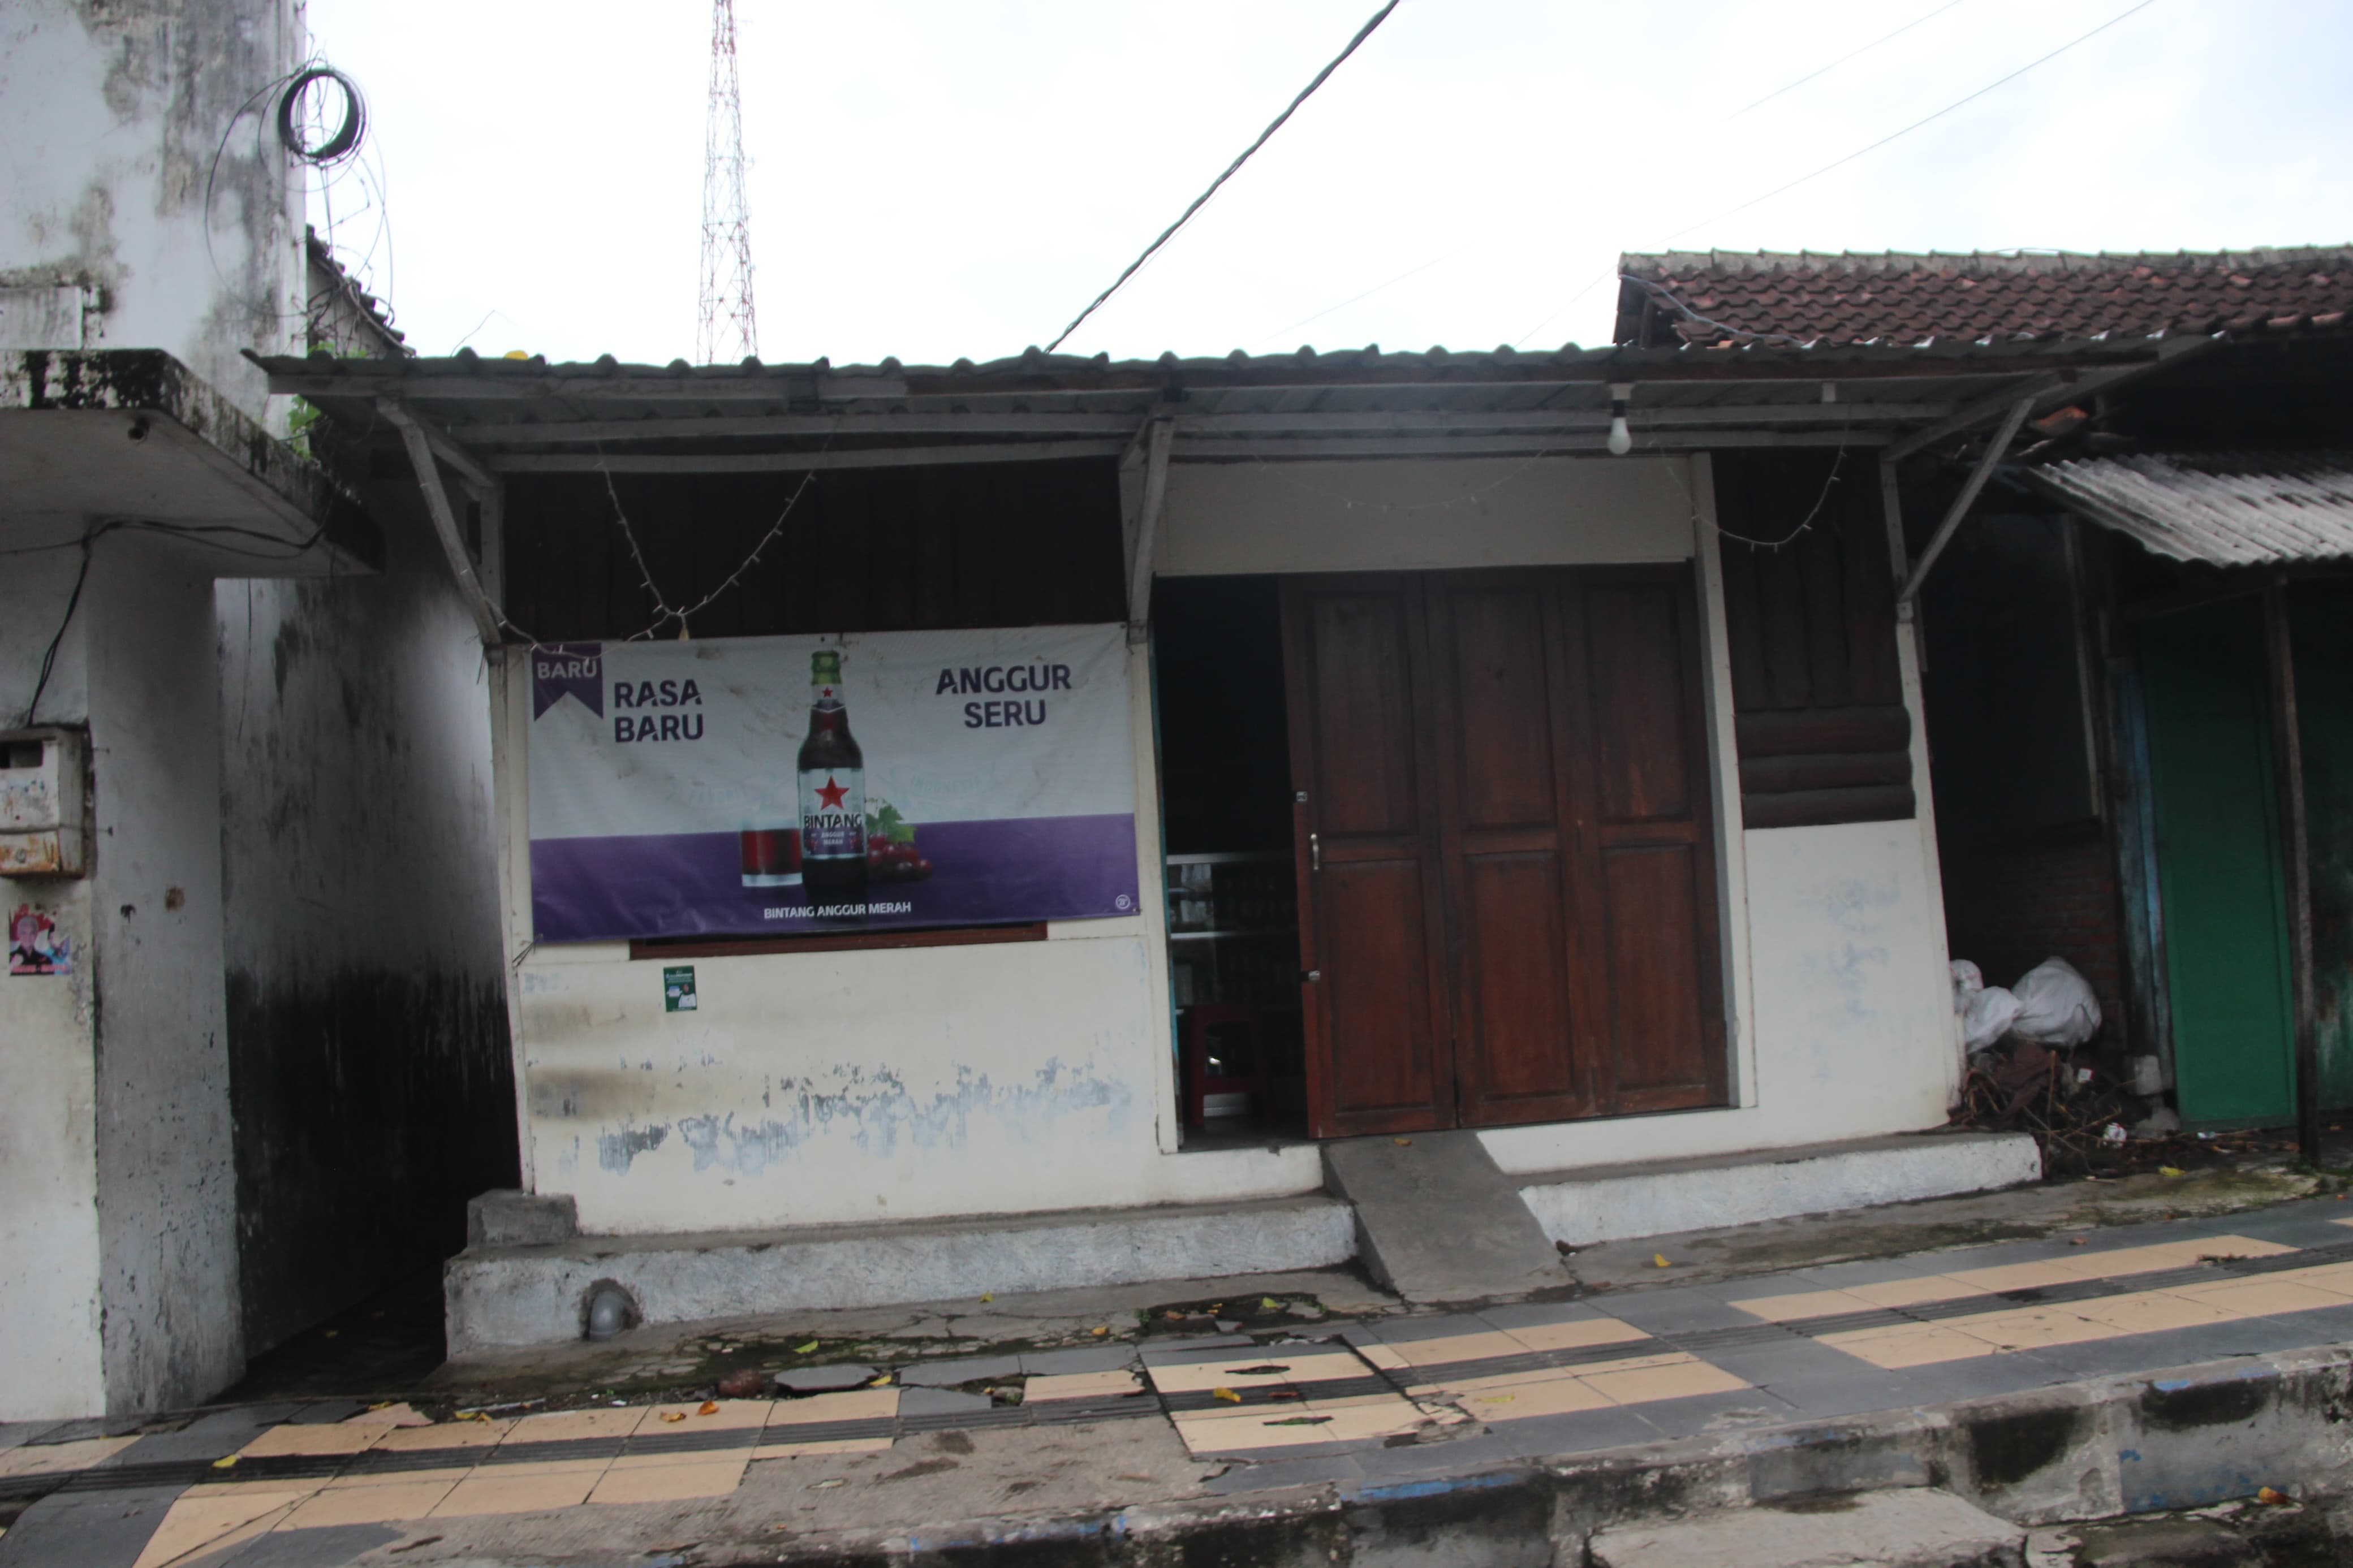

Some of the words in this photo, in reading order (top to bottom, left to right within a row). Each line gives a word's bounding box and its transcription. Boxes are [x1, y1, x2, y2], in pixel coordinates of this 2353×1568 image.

[538, 661, 597, 679] BARU
[936, 664, 1072, 695] ANGGUR
[614, 679, 703, 708] RASA
[964, 699, 1046, 728] SERU
[615, 714, 703, 742] BARU
[804, 814, 863, 828] BINTANG
[764, 906, 815, 919] BINTANG
[817, 905, 866, 917] ANGGUR
[868, 901, 911, 914] MERAH
